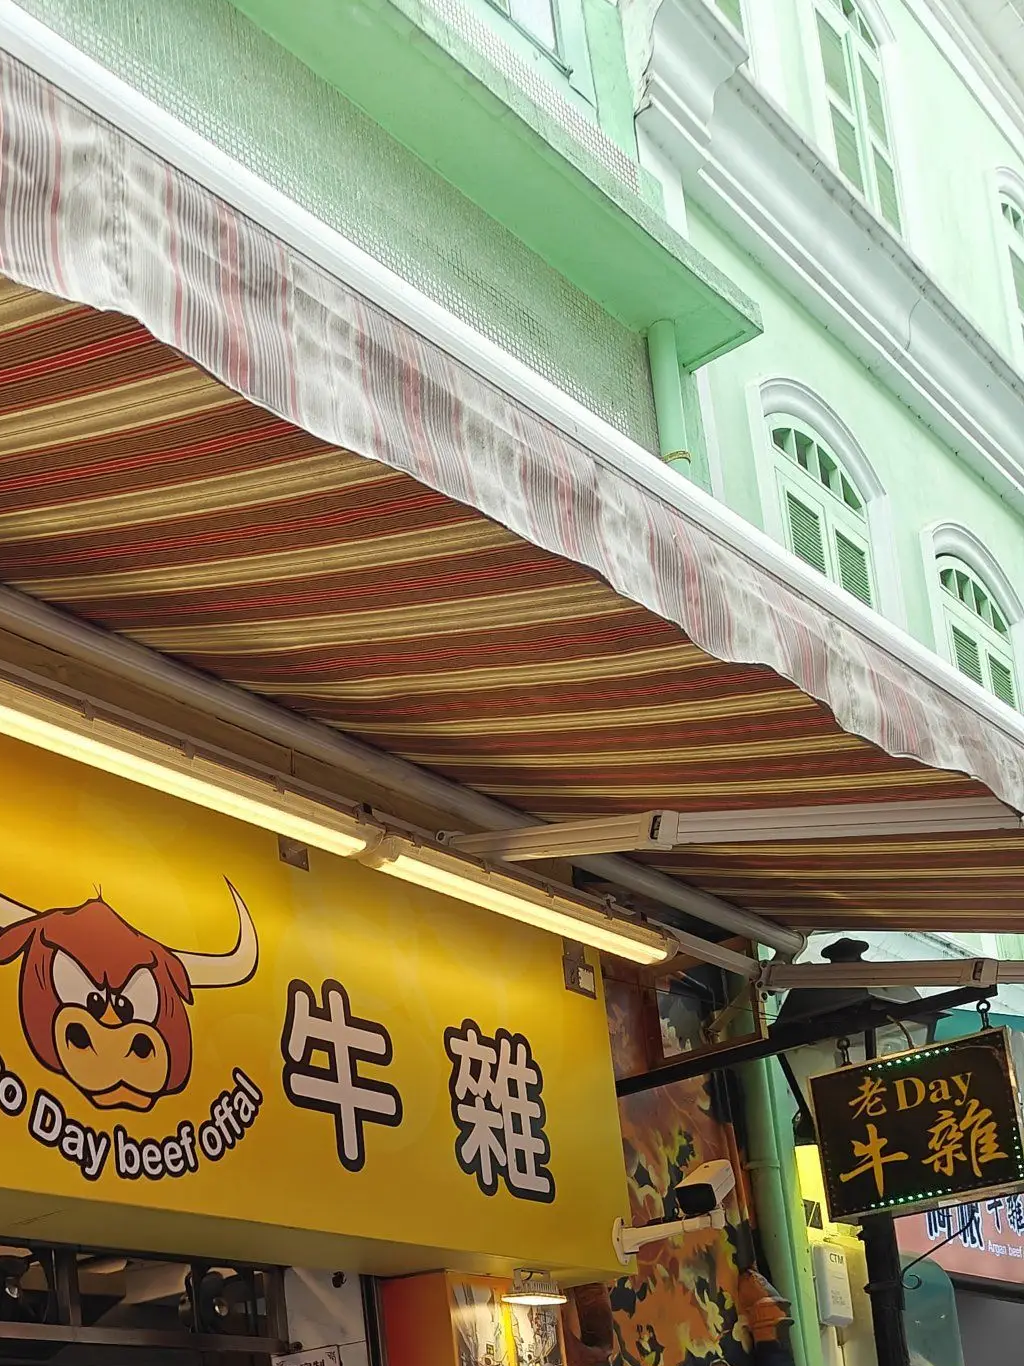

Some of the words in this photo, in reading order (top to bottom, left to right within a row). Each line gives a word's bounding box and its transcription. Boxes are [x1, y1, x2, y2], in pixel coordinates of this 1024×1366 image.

[27, 1088, 111, 1182] Day
[115, 1117, 197, 1181] beef
[193, 1067, 264, 1161] offal
[829, 1253, 844, 1265] CTM
